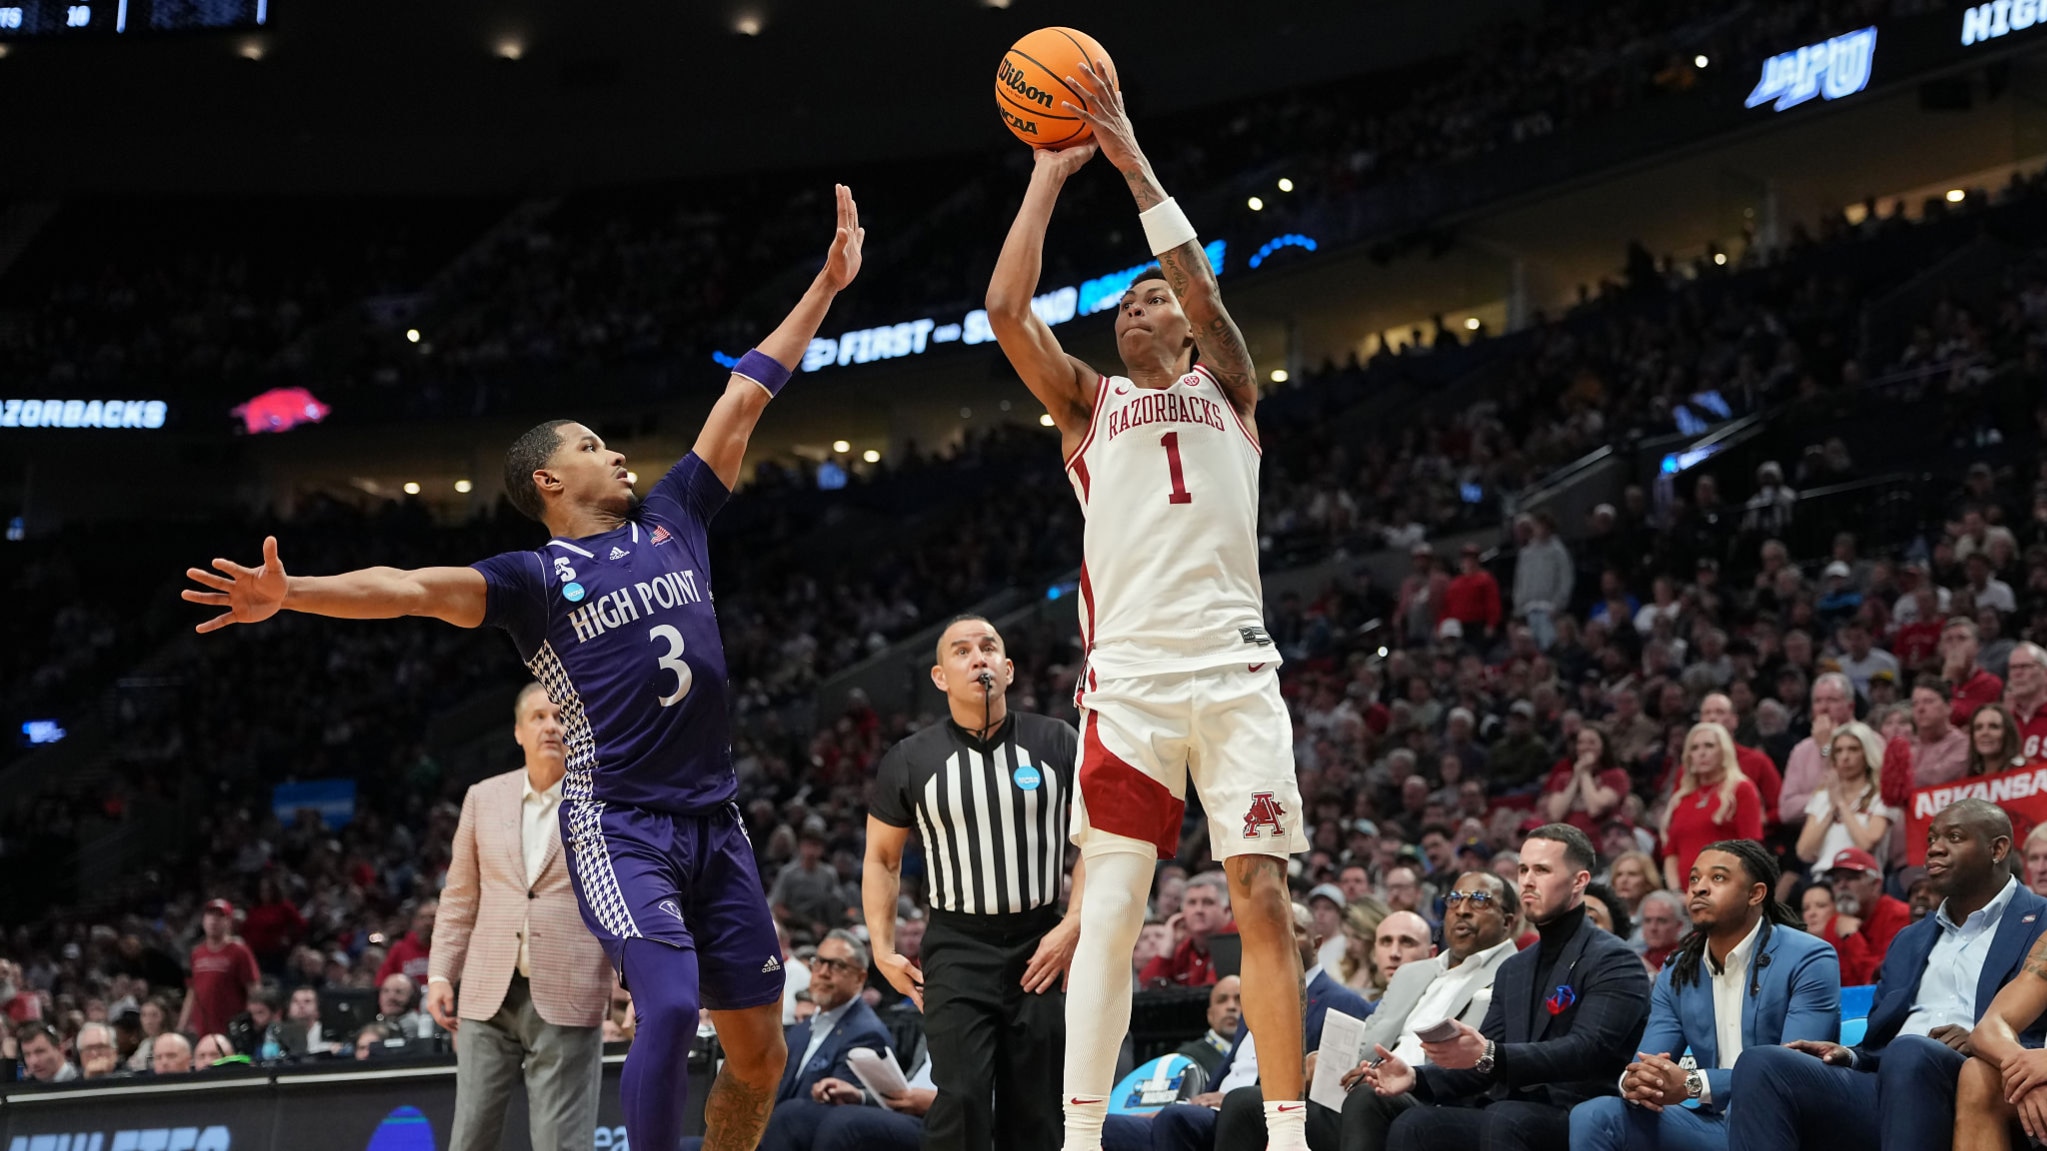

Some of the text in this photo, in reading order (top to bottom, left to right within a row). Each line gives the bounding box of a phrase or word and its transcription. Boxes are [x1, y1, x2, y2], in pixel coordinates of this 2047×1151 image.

[999, 57, 1054, 110] Wilson
[837, 317, 935, 367] FIRST
[0, 399, 168, 429] ZORBACKS
[1109, 393, 1225, 441] RAZORBACKS
[1160, 431, 1192, 505] 1
[567, 569, 702, 644] HIGH POINT
[650, 624, 693, 707] 3
